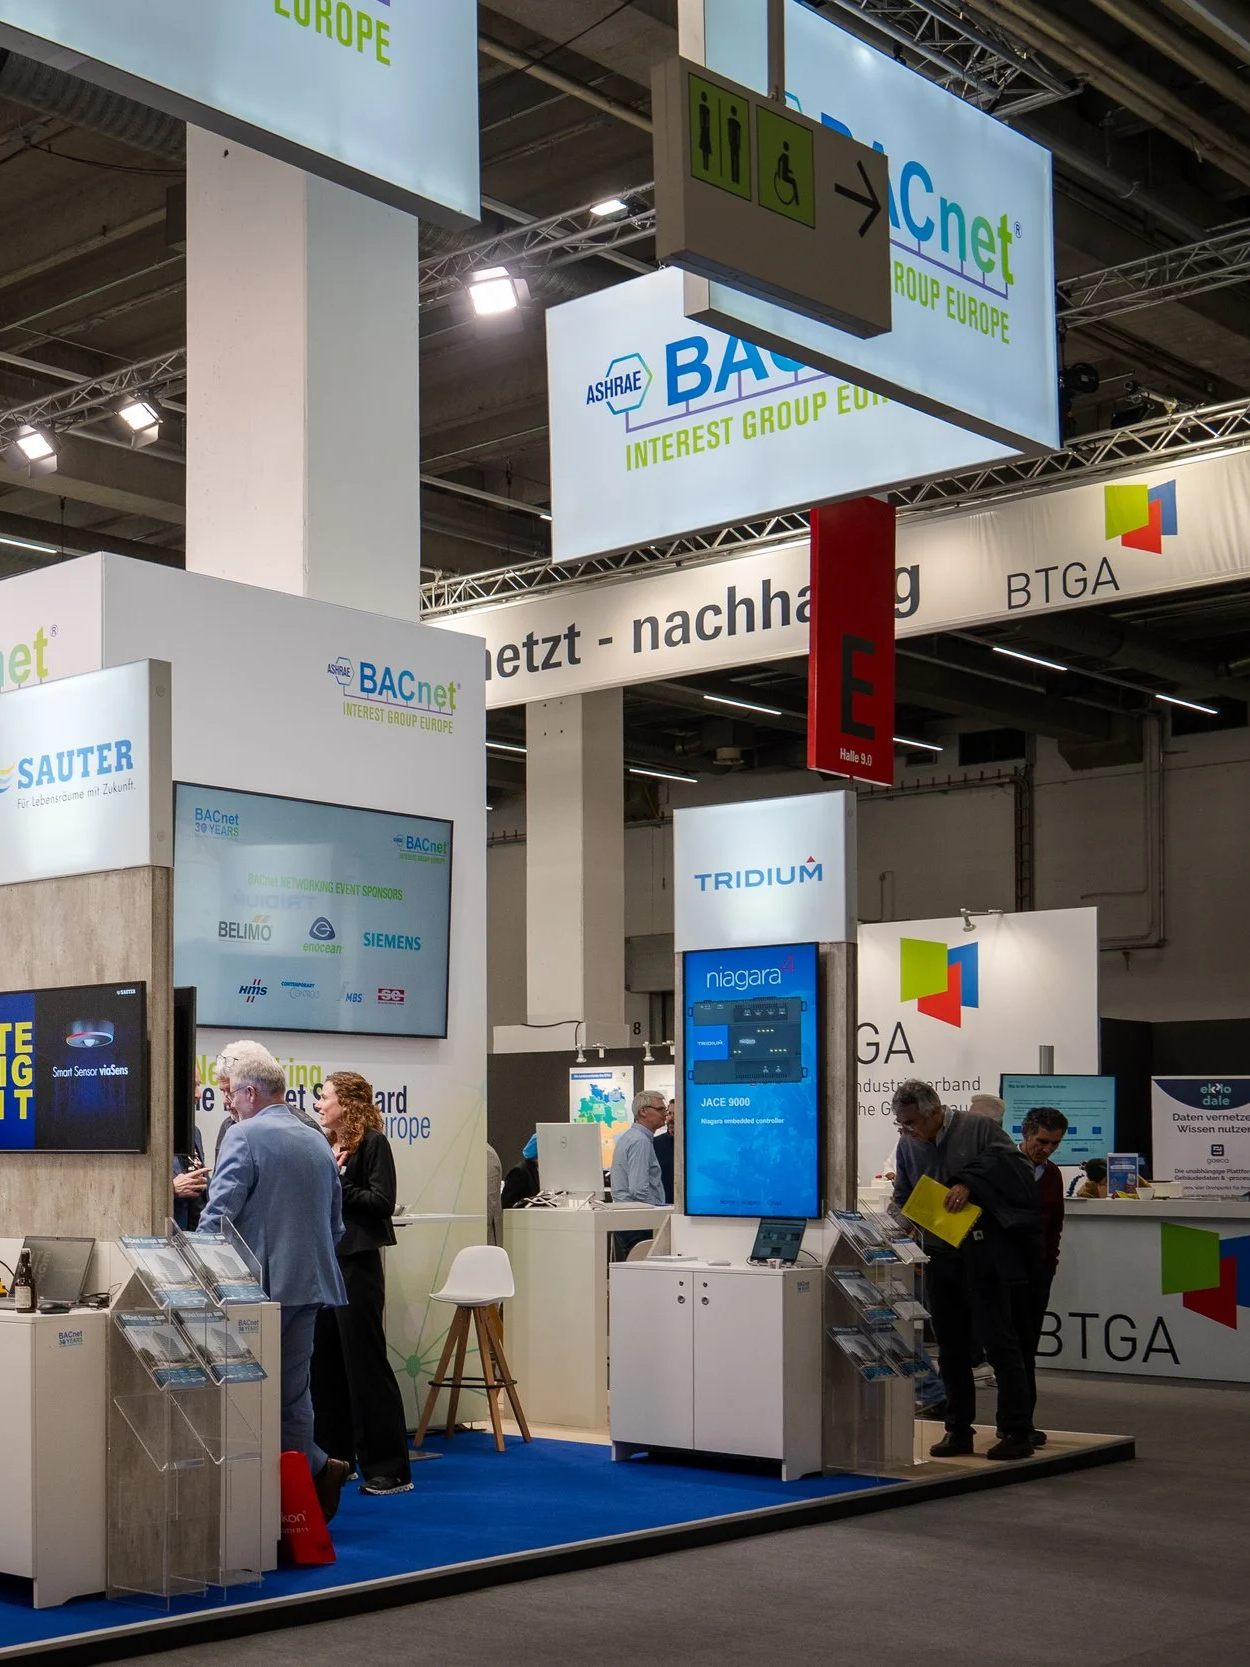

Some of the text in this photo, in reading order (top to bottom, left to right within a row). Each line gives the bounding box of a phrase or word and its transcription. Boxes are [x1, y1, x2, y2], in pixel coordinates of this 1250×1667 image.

[894, 260, 1010, 344] ROUP EUROPE
[586, 370, 642, 405] ASHRAE
[626, 416, 733, 472] INTEREST
[743, 391, 827, 440] GROUP
[1007, 556, 1121, 611] BTGA
[485, 622, 582, 681] etzt
[327, 661, 457, 710] ASHRAE BACnet
[841, 633, 876, 741] E
[343, 701, 453, 734] INTEREST GROUP EUROPE
[17, 738, 134, 790] SAUTER
[839, 747, 872, 767] Halle 9.0
[17, 780, 137, 809] Für Lebensräume mit Zukunft.
[195, 808, 239, 825] BACnet
[209, 823, 239, 837] YEARS
[406, 835, 447, 854] BACnet
[694, 862, 823, 892] TRIDIUM
[279, 876, 334, 893] NETWORKING
[335, 882, 361, 896] EVENT
[362, 885, 403, 901] SPONSORS
[218, 921, 272, 942] BELIMO
[363, 932, 422, 951] SIEMENS
[302, 942, 342, 955] enocean
[345, 992, 363, 1003] MBS
[633, 1022, 641, 1035] 8
[52, 1064, 129, 1078] Smart Sensor viaSens
[701, 1097, 750, 1107] JACE 9000
[1202, 1096, 1230, 1106] dale
[701, 1118, 723, 1126] Niagara
[755, 1117, 784, 1125] controller
[1172, 1112, 1203, 1122] Daten
[1177, 1125, 1215, 1133] Wissen
[1035, 1311, 1180, 1365] BTGA
